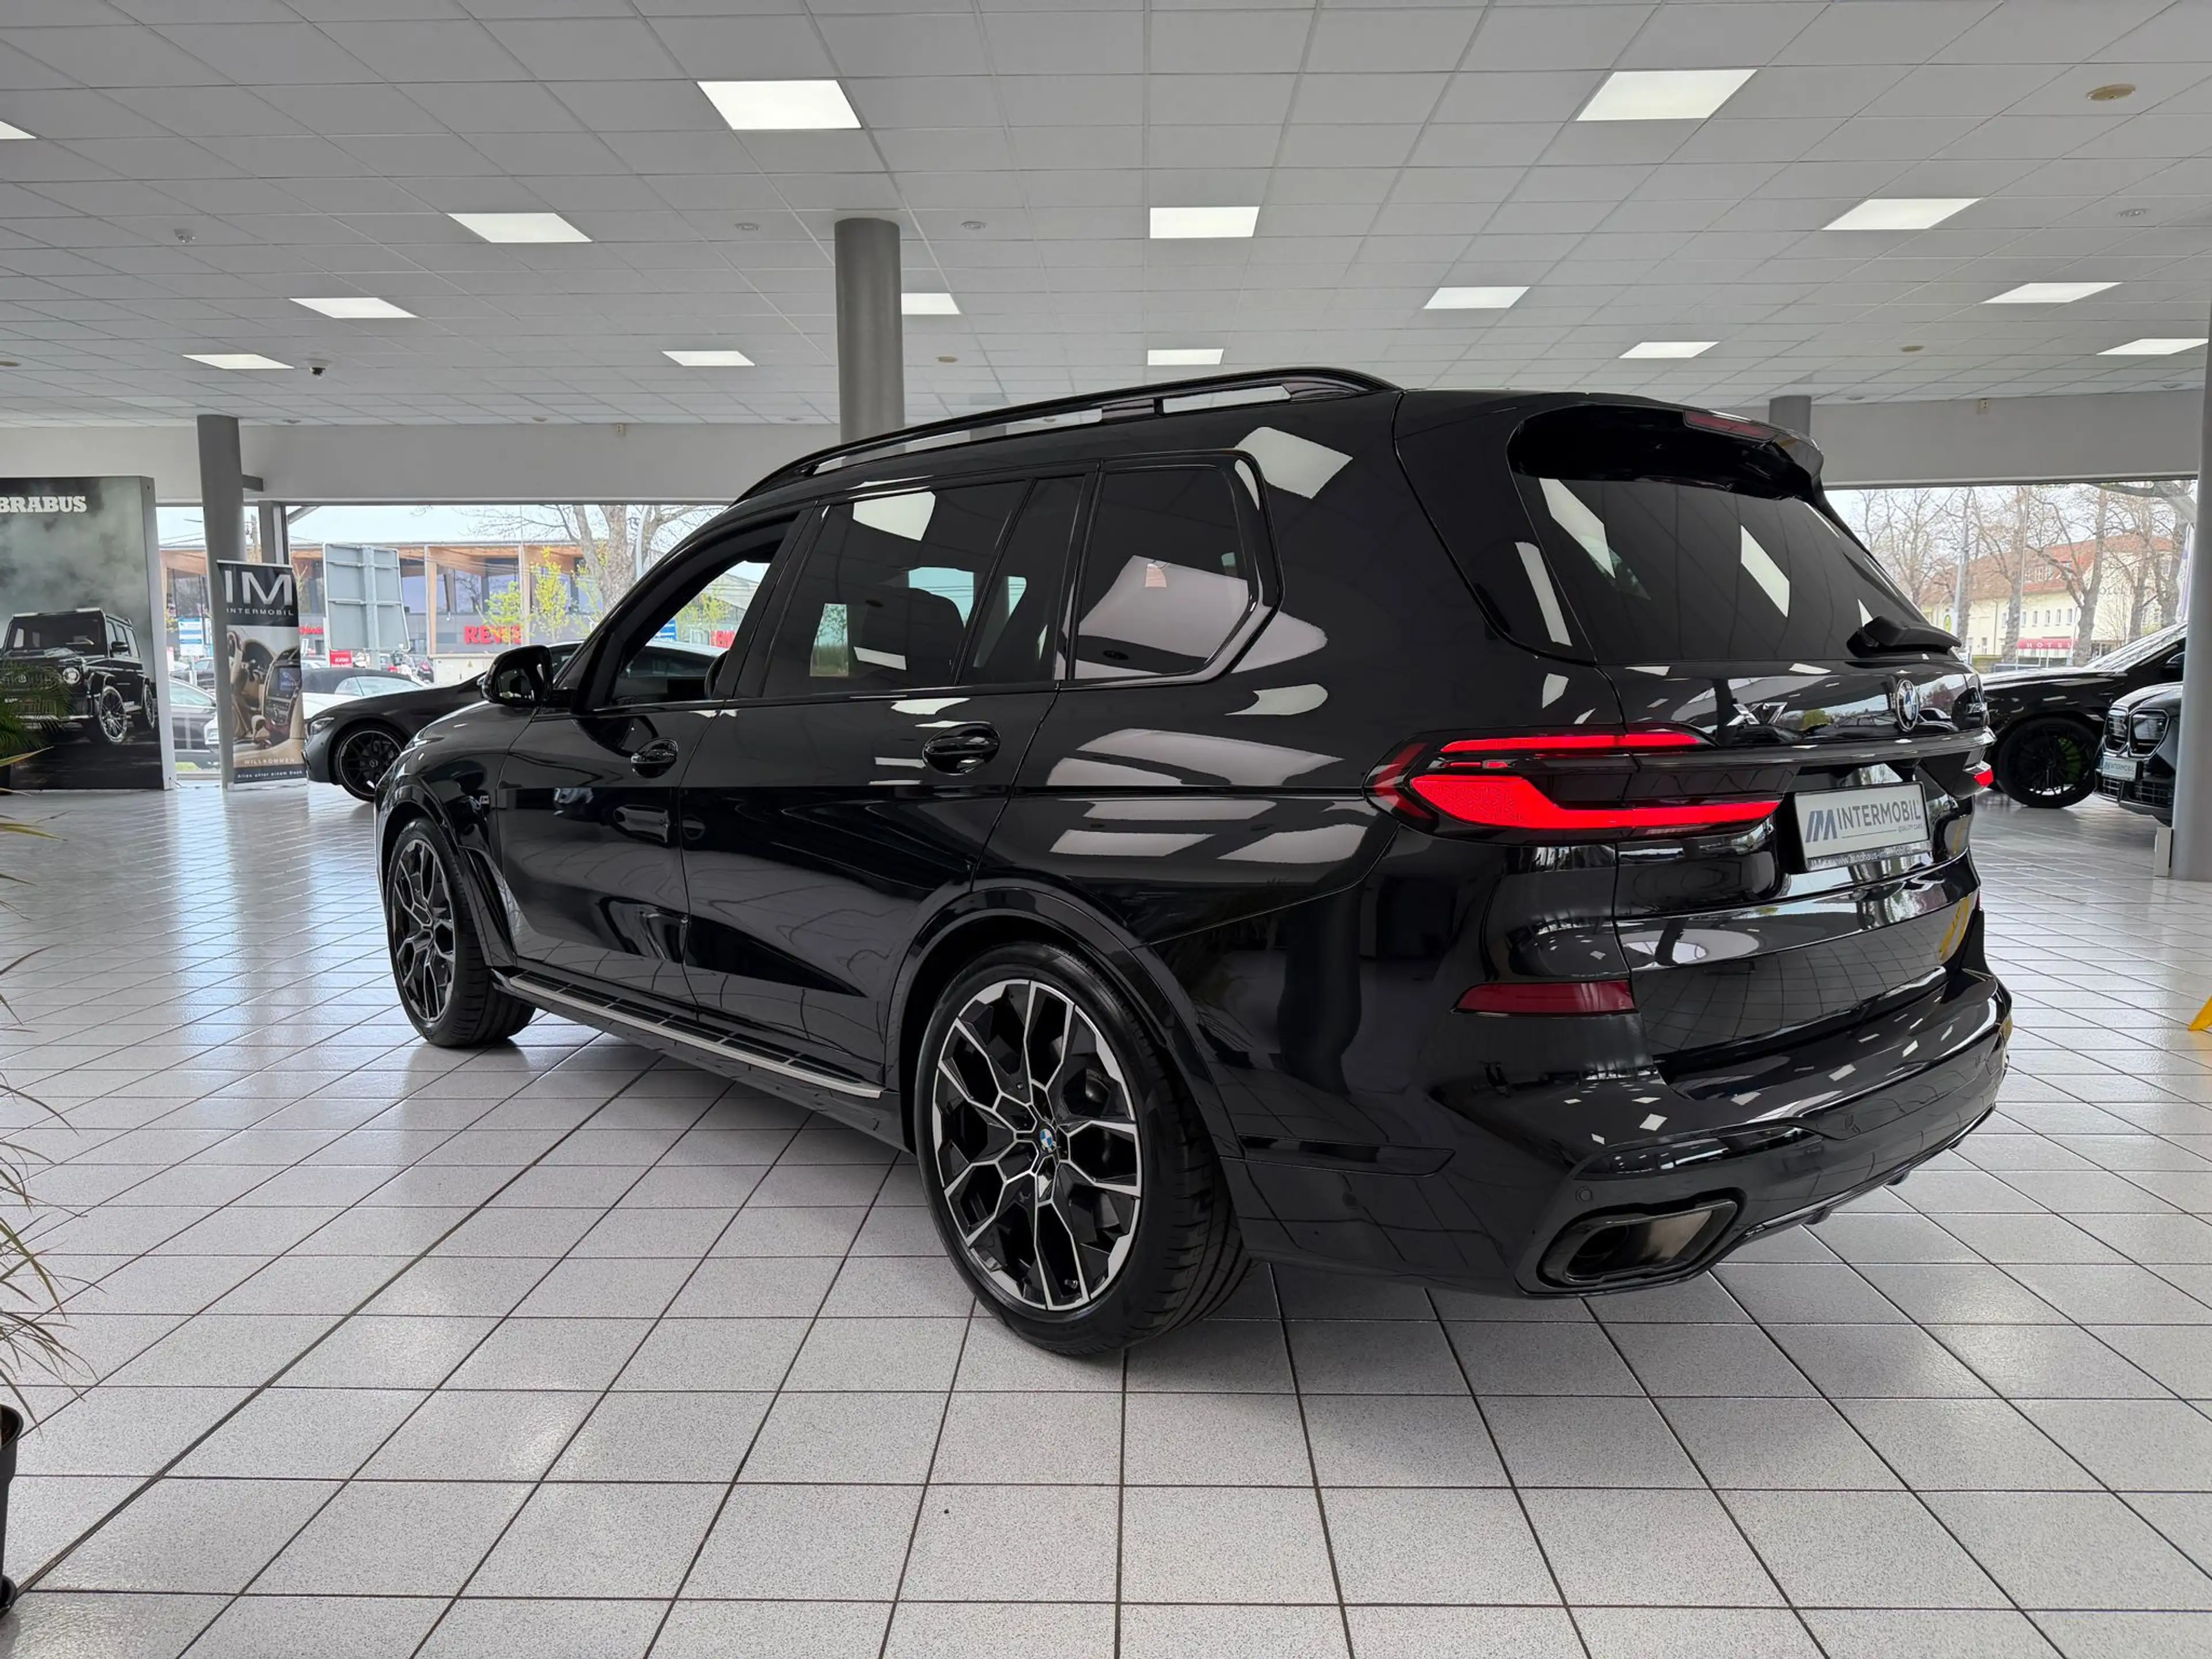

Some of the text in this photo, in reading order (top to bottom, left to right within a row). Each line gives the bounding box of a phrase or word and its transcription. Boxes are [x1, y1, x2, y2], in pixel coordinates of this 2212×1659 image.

[0, 496, 87, 513] BRABUS
[225, 570, 293, 605] IM
[226, 608, 294, 616] INTERMOBIL
[1726, 702, 1787, 726] X7
[1836, 799, 1921, 830] INTERMOBIL
